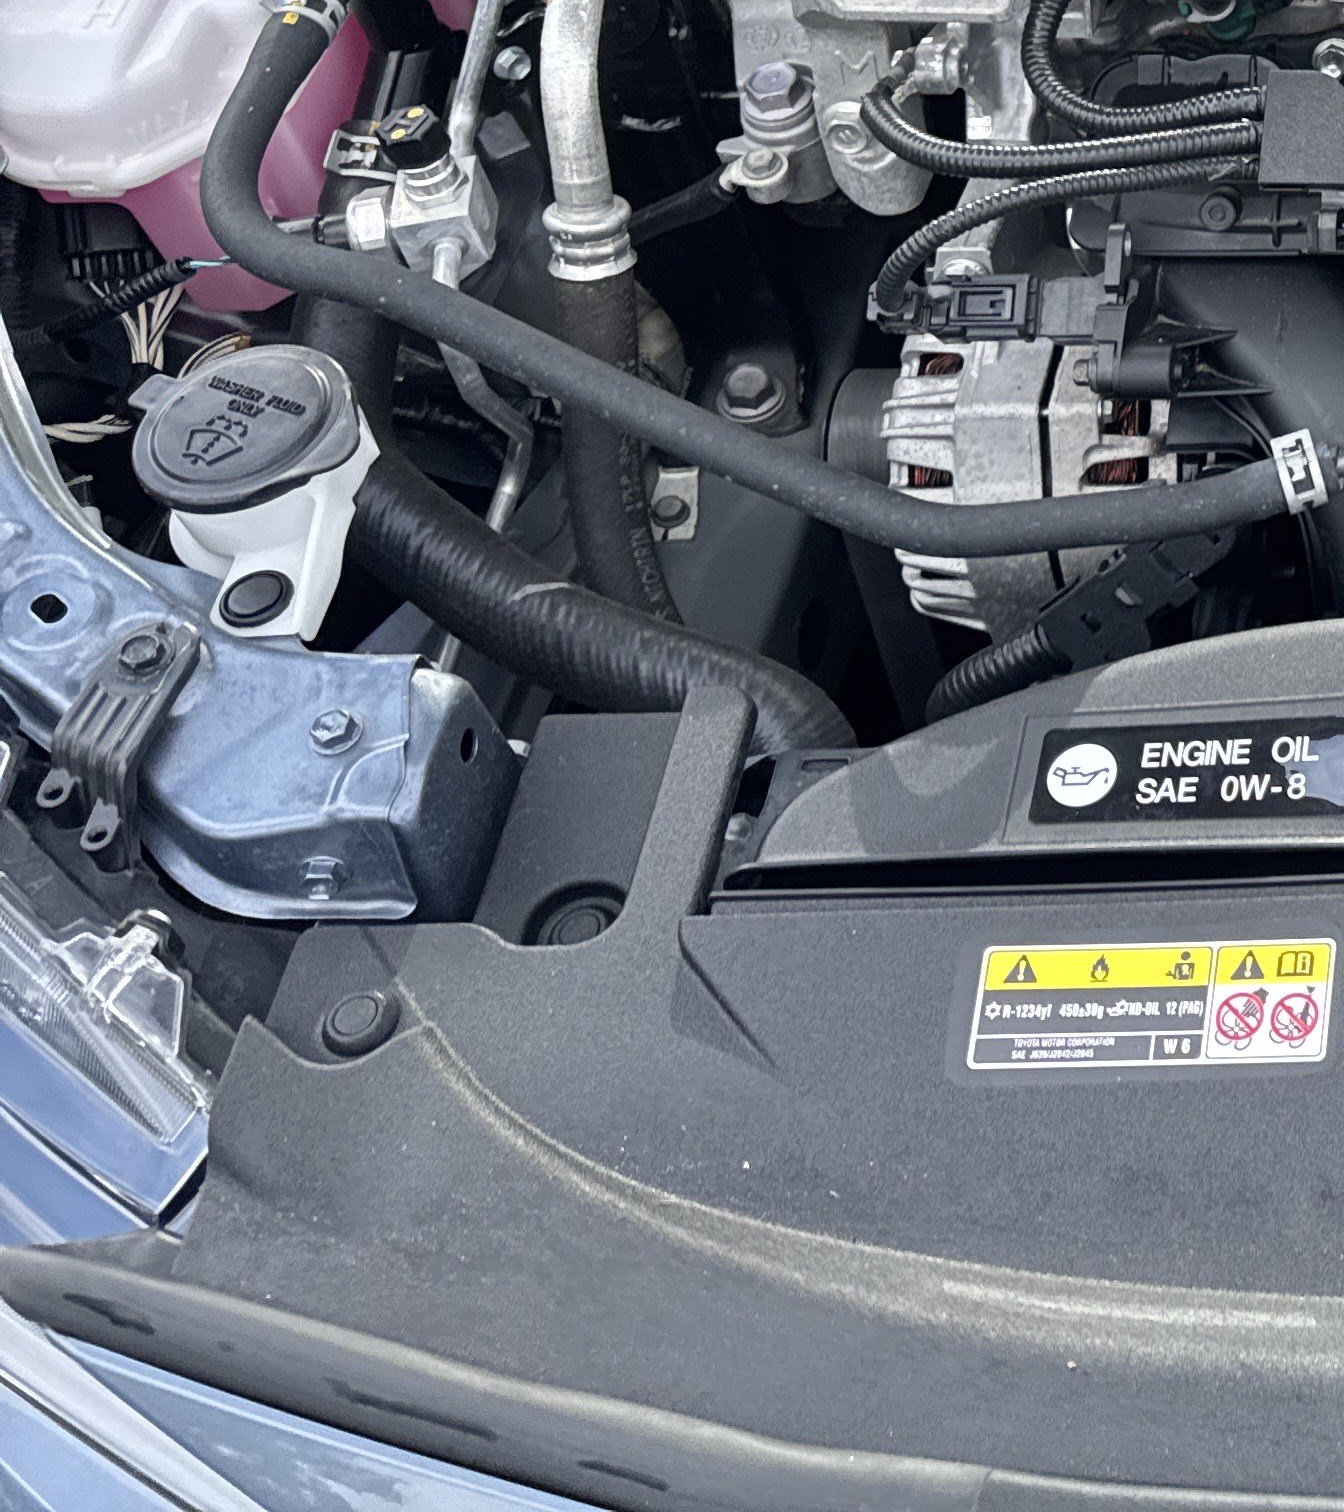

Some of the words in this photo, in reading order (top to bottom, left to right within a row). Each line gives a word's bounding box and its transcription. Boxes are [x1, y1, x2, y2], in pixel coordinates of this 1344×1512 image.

[1140, 738, 1253, 769] ENGINE
[1271, 735, 1320, 764] OIL
[1135, 776, 1200, 805] SAE
[1220, 773, 1307, 803] 0W-8
[1002, 1003, 1053, 1020] R-1234yf
[1059, 1002, 1105, 1020] 450±30g
[1127, 1001, 1161, 1017] ND-OIL
[1166, 1001, 1178, 1016] 12
[1178, 1000, 1204, 1018] (PAG)
[1014, 1038, 1041, 1049] TOYOTA
[1041, 1038, 1066, 1048] MOTOR
[1067, 1037, 1116, 1047] CORPORATION
[1163, 1039, 1178, 1055] W
[1181, 1038, 1191, 1054] 6
[1012, 1050, 1026, 1060] SAE
